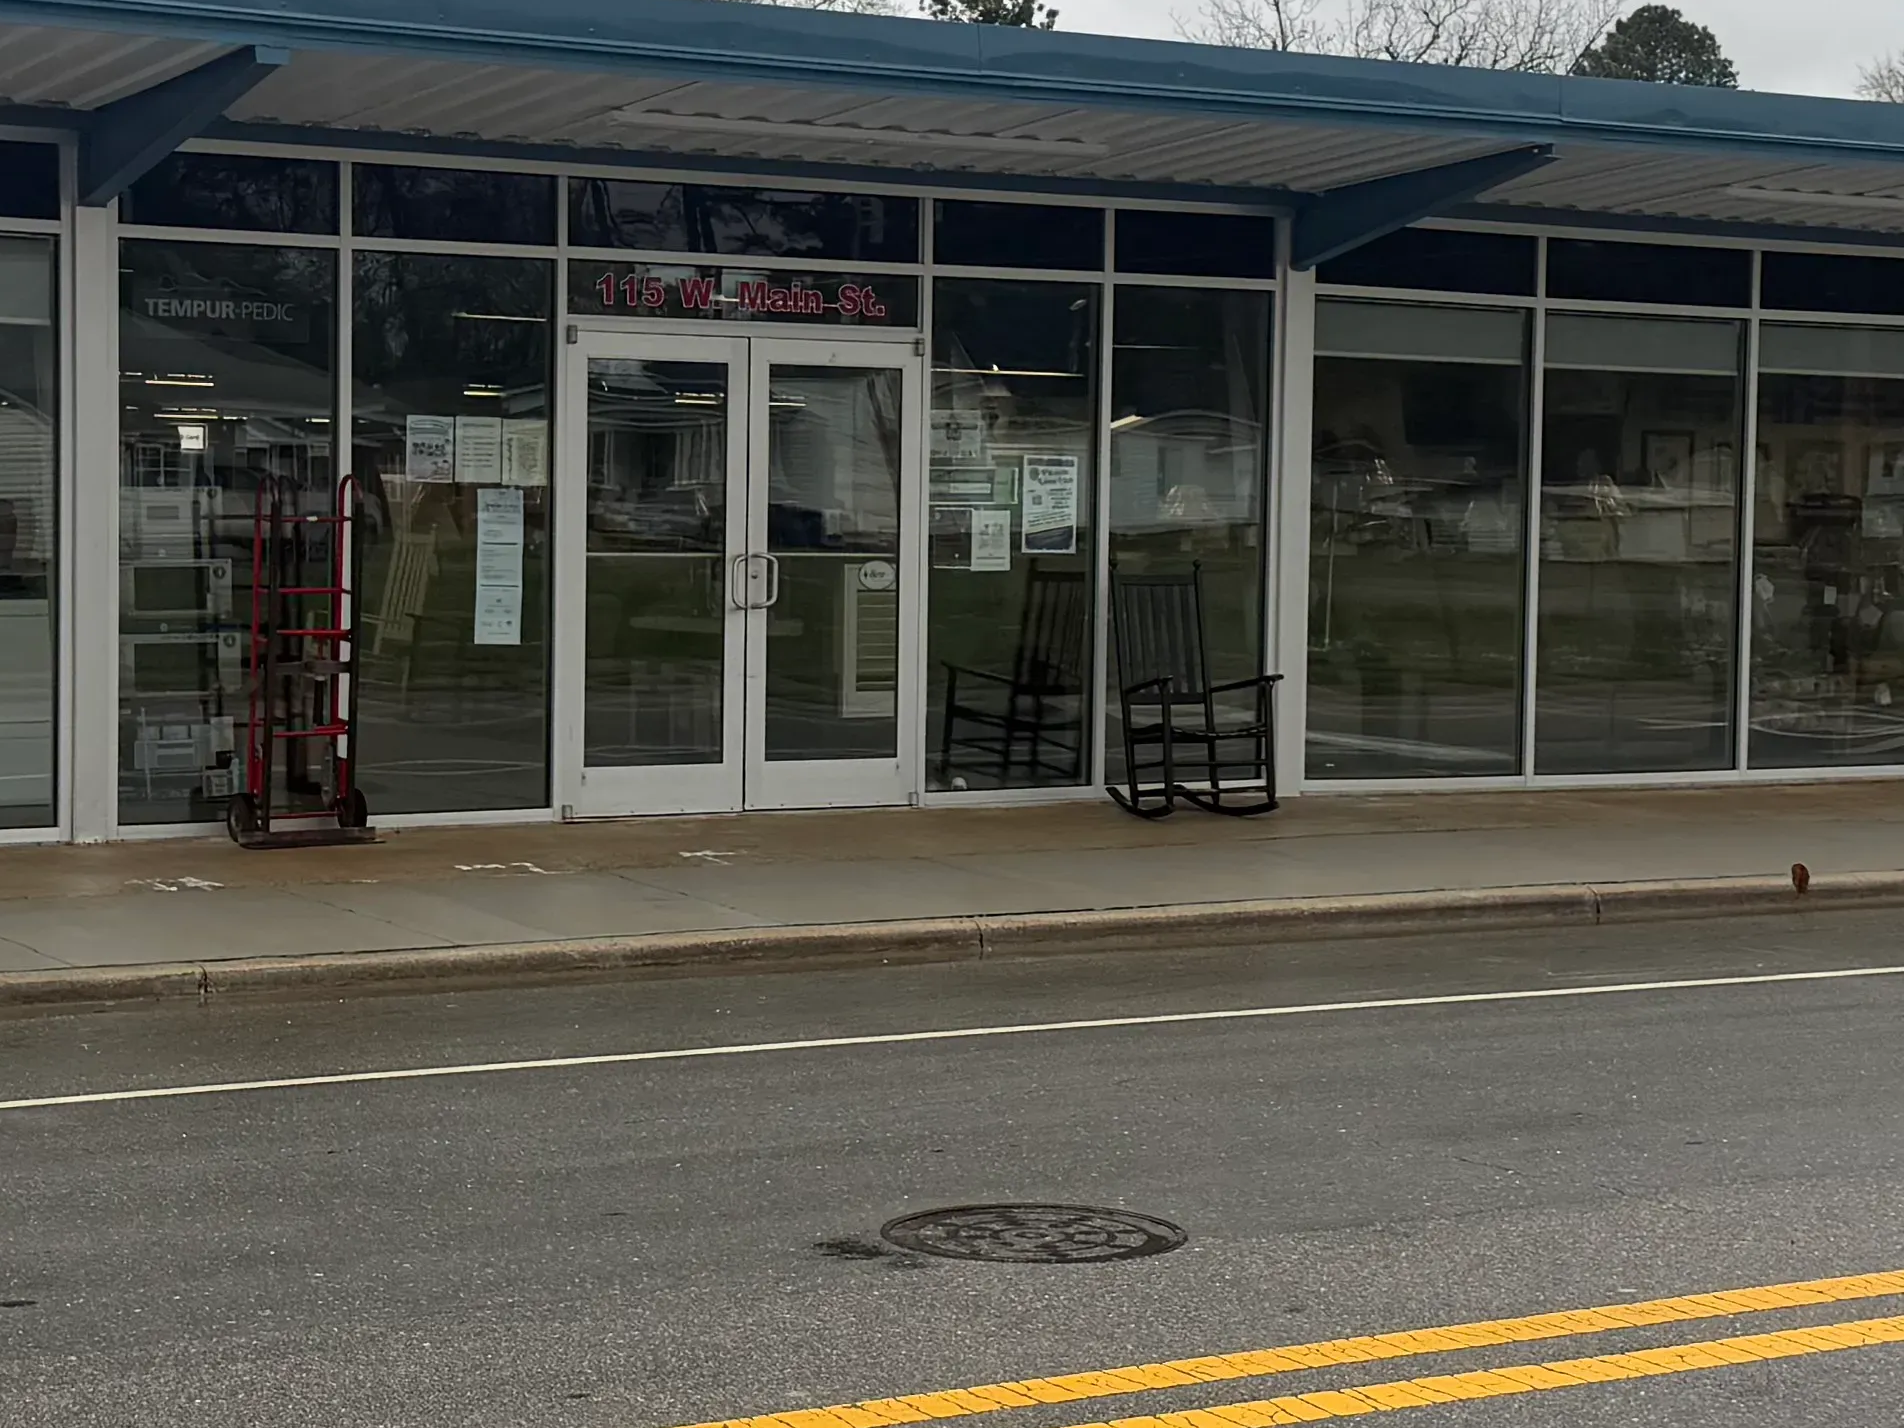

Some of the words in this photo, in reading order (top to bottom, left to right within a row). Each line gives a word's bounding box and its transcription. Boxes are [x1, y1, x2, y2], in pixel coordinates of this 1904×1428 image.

[144, 298, 296, 321] TEMPUR-PEDIC
[596, 273, 665, 307] 115
[737, 280, 824, 314] Main
[837, 283, 886, 317] St.
